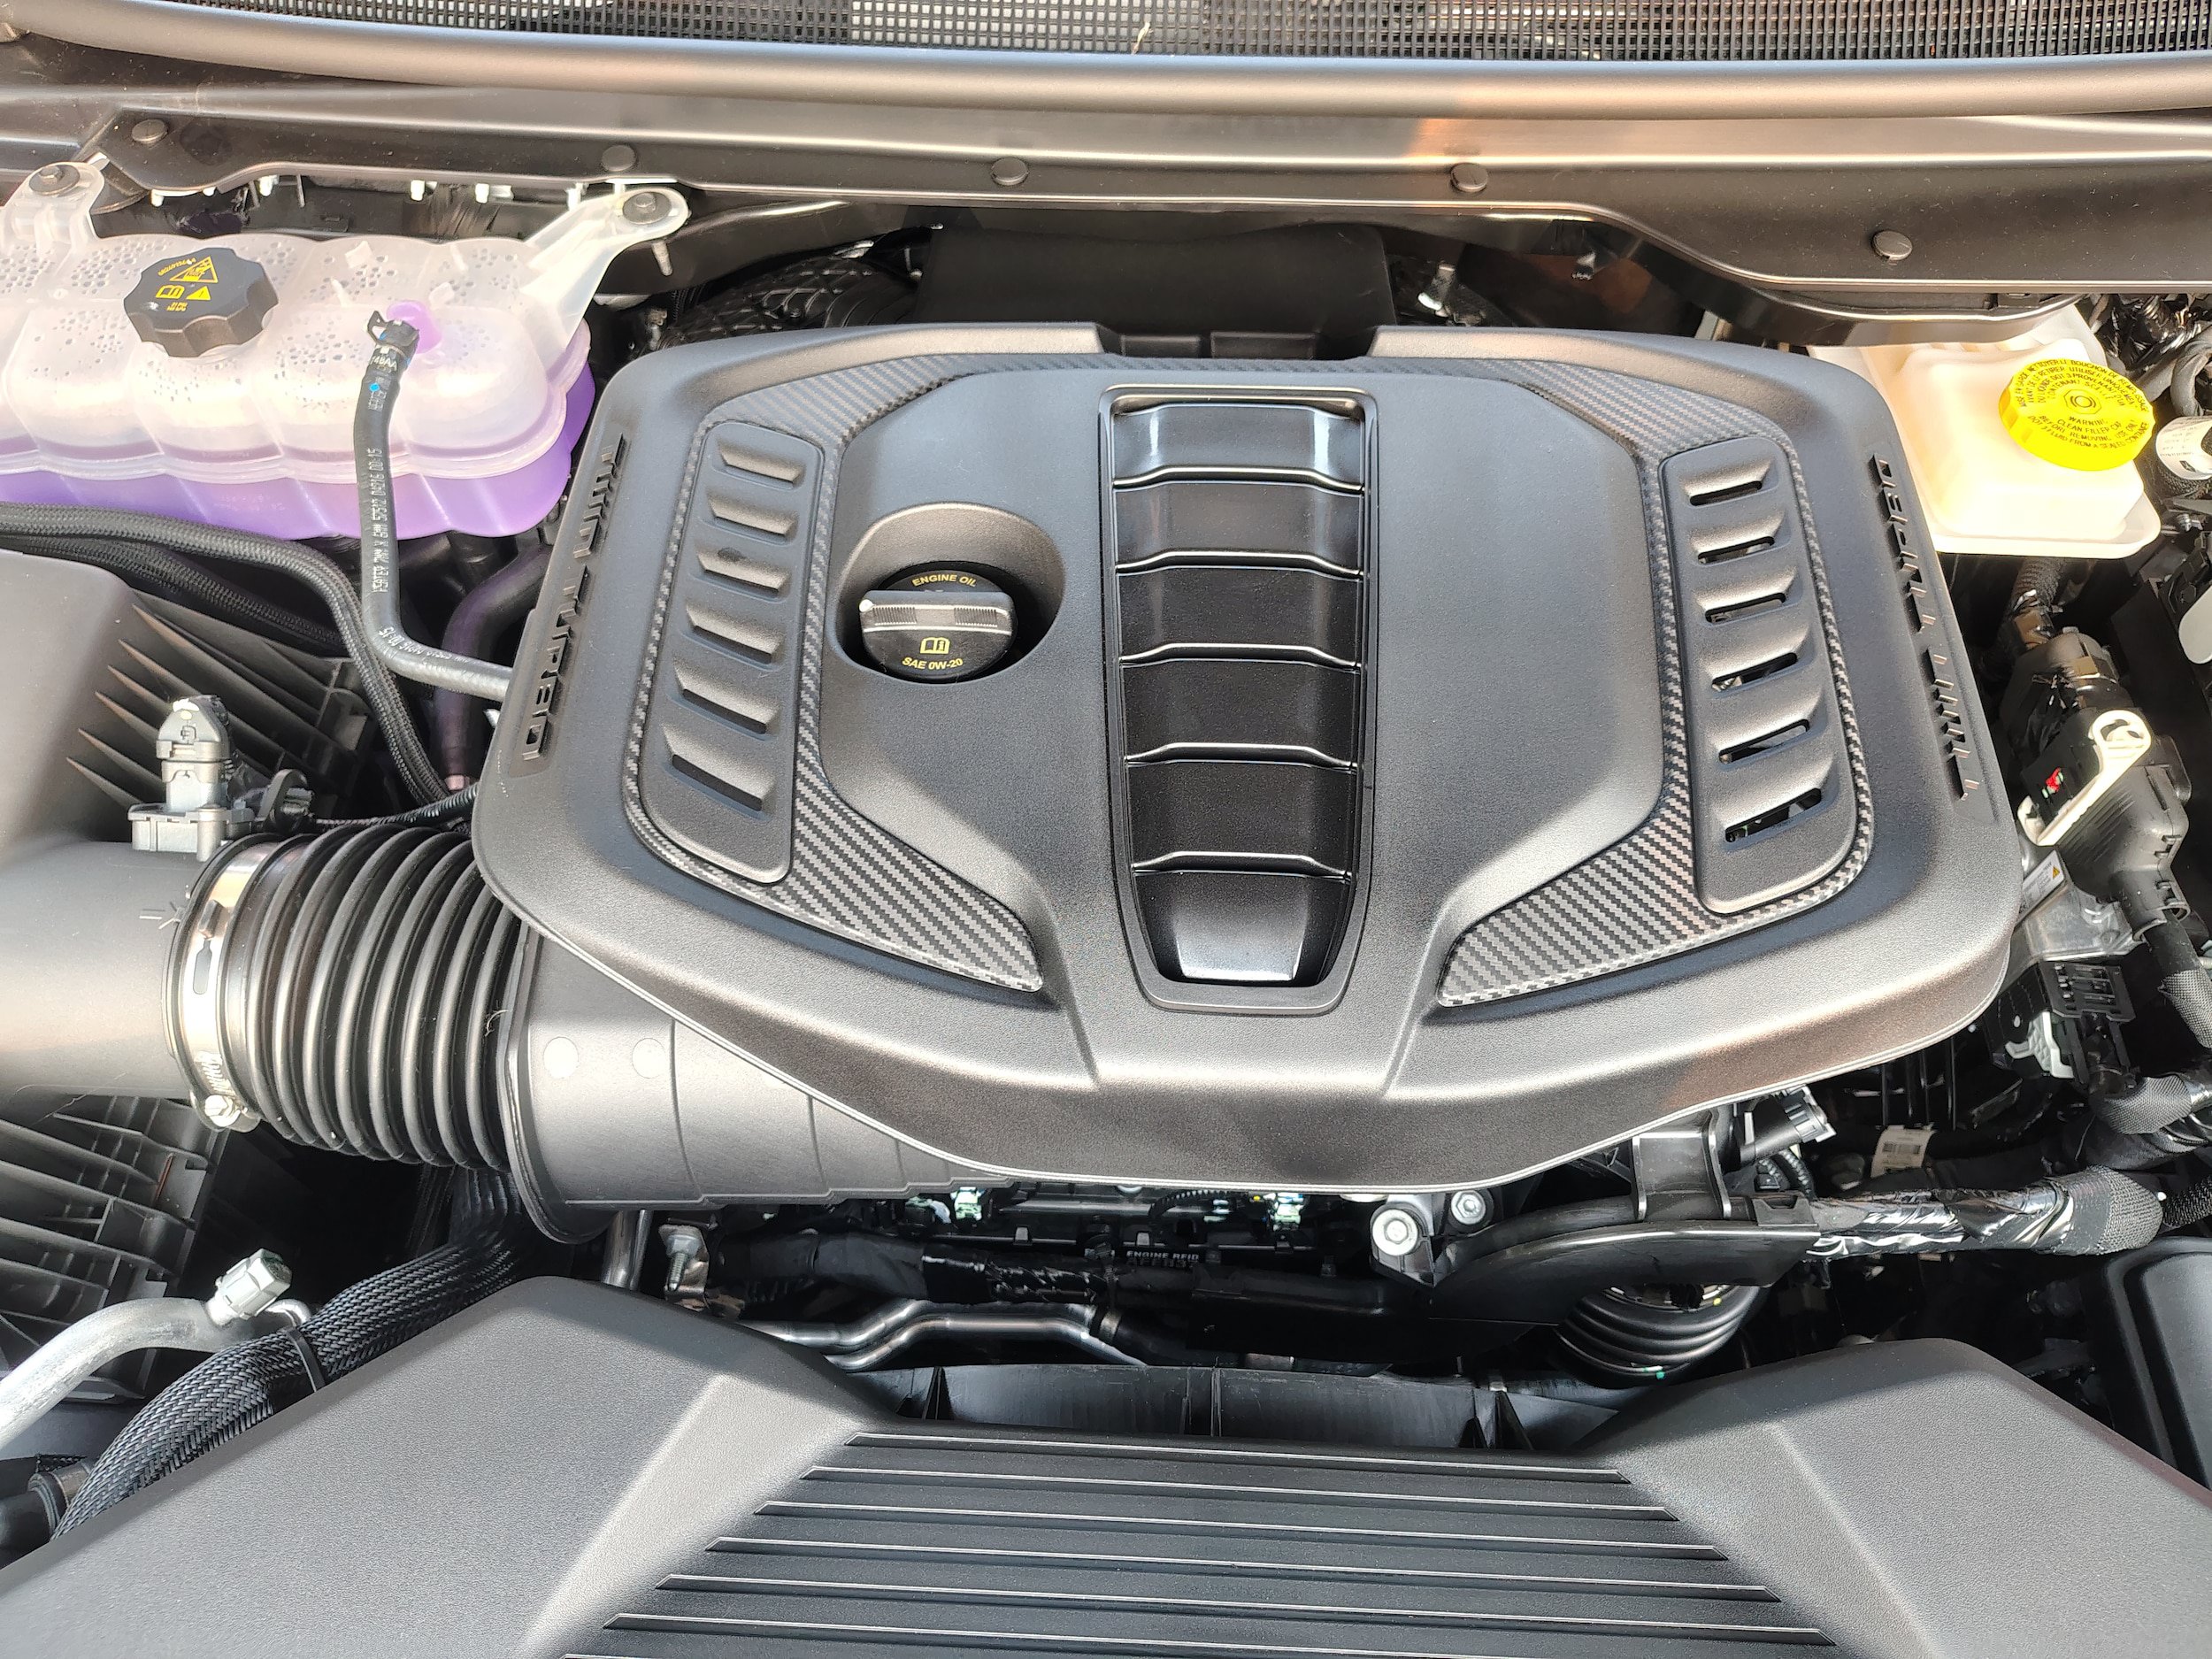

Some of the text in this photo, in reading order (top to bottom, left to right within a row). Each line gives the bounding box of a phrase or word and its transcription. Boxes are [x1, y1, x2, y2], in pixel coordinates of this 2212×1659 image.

[1865, 451, 1938, 635] TURBO
[911, 574, 978, 588] ENGINE OIL
[518, 565, 589, 762] TURBO
[901, 657, 964, 670] SAE 0W-20
[1125, 1250, 1170, 1260] ENGINE
